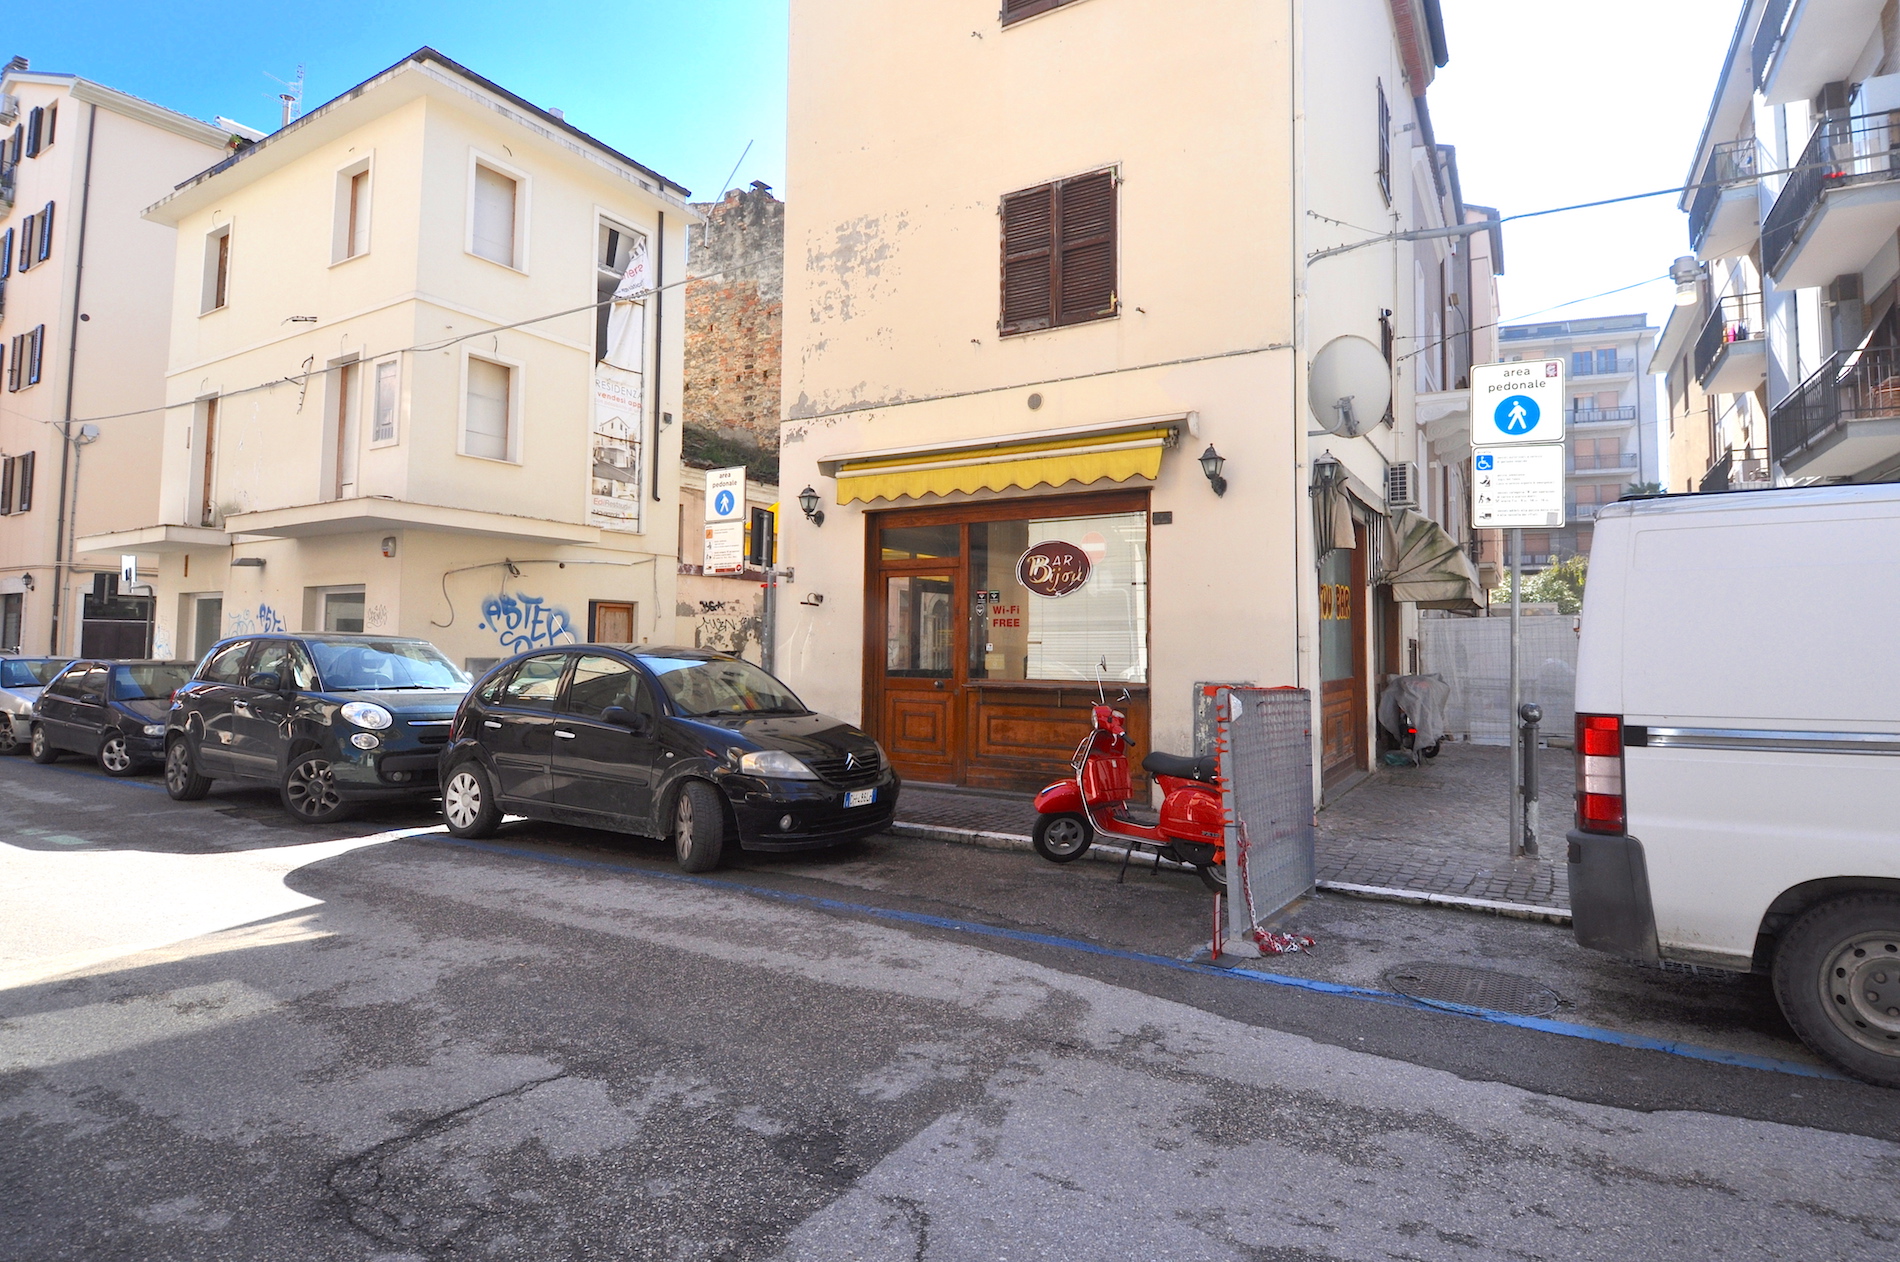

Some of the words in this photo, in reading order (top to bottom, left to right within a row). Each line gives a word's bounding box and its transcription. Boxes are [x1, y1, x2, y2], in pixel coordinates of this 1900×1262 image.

[1503, 368, 1531, 378] area
[1488, 379, 1547, 394] pedonale
[597, 392, 626, 404] vendesi
[712, 480, 738, 489] pedonale
[992, 605, 1020, 615] Wi-Fi
[992, 618, 1020, 628] FREE
